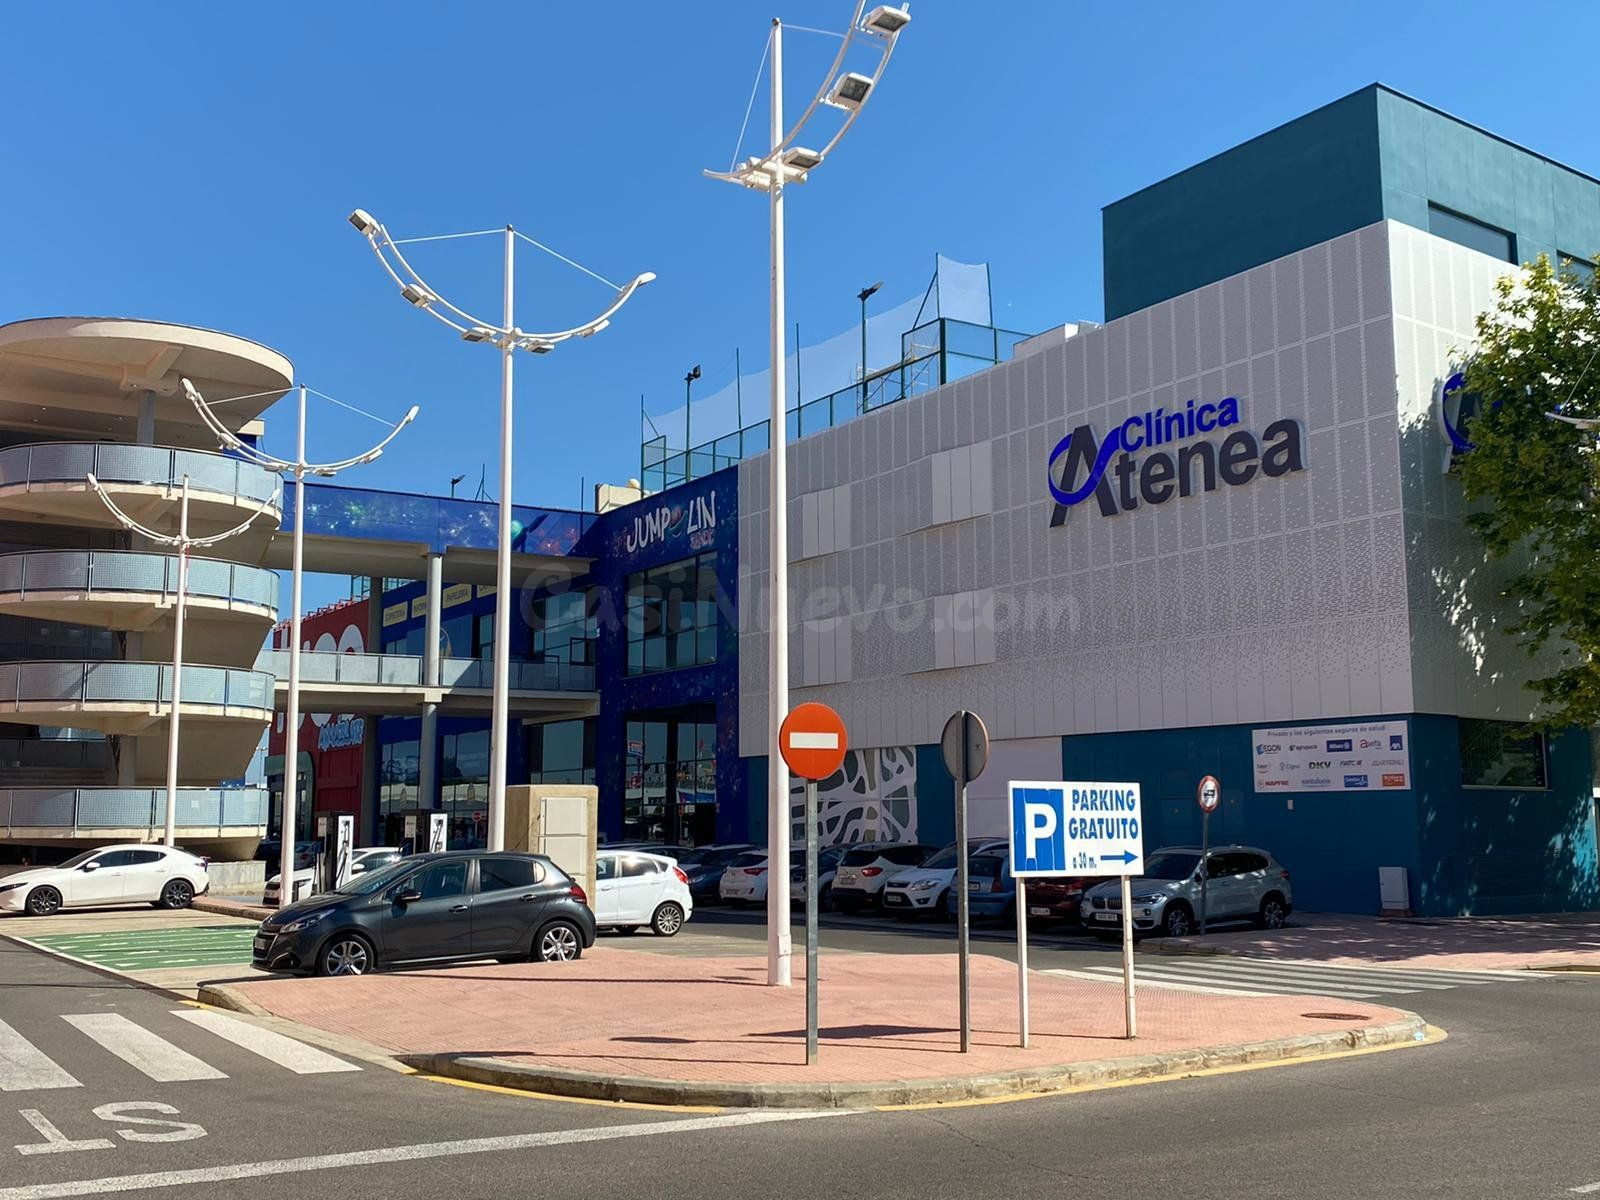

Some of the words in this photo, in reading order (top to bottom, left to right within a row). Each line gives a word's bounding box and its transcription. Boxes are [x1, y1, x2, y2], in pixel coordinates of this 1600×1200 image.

[1119, 397, 1239, 452] Clínica
[1049, 419, 1304, 528] Atenea
[1309, 761, 1331, 769] DKV
[1072, 789, 1136, 811] PARKING
[1025, 803, 1057, 859] P
[1068, 818, 1138, 839] GRATUITO
[1073, 856, 1077, 869] a
[1079, 852, 1087, 869] 30
